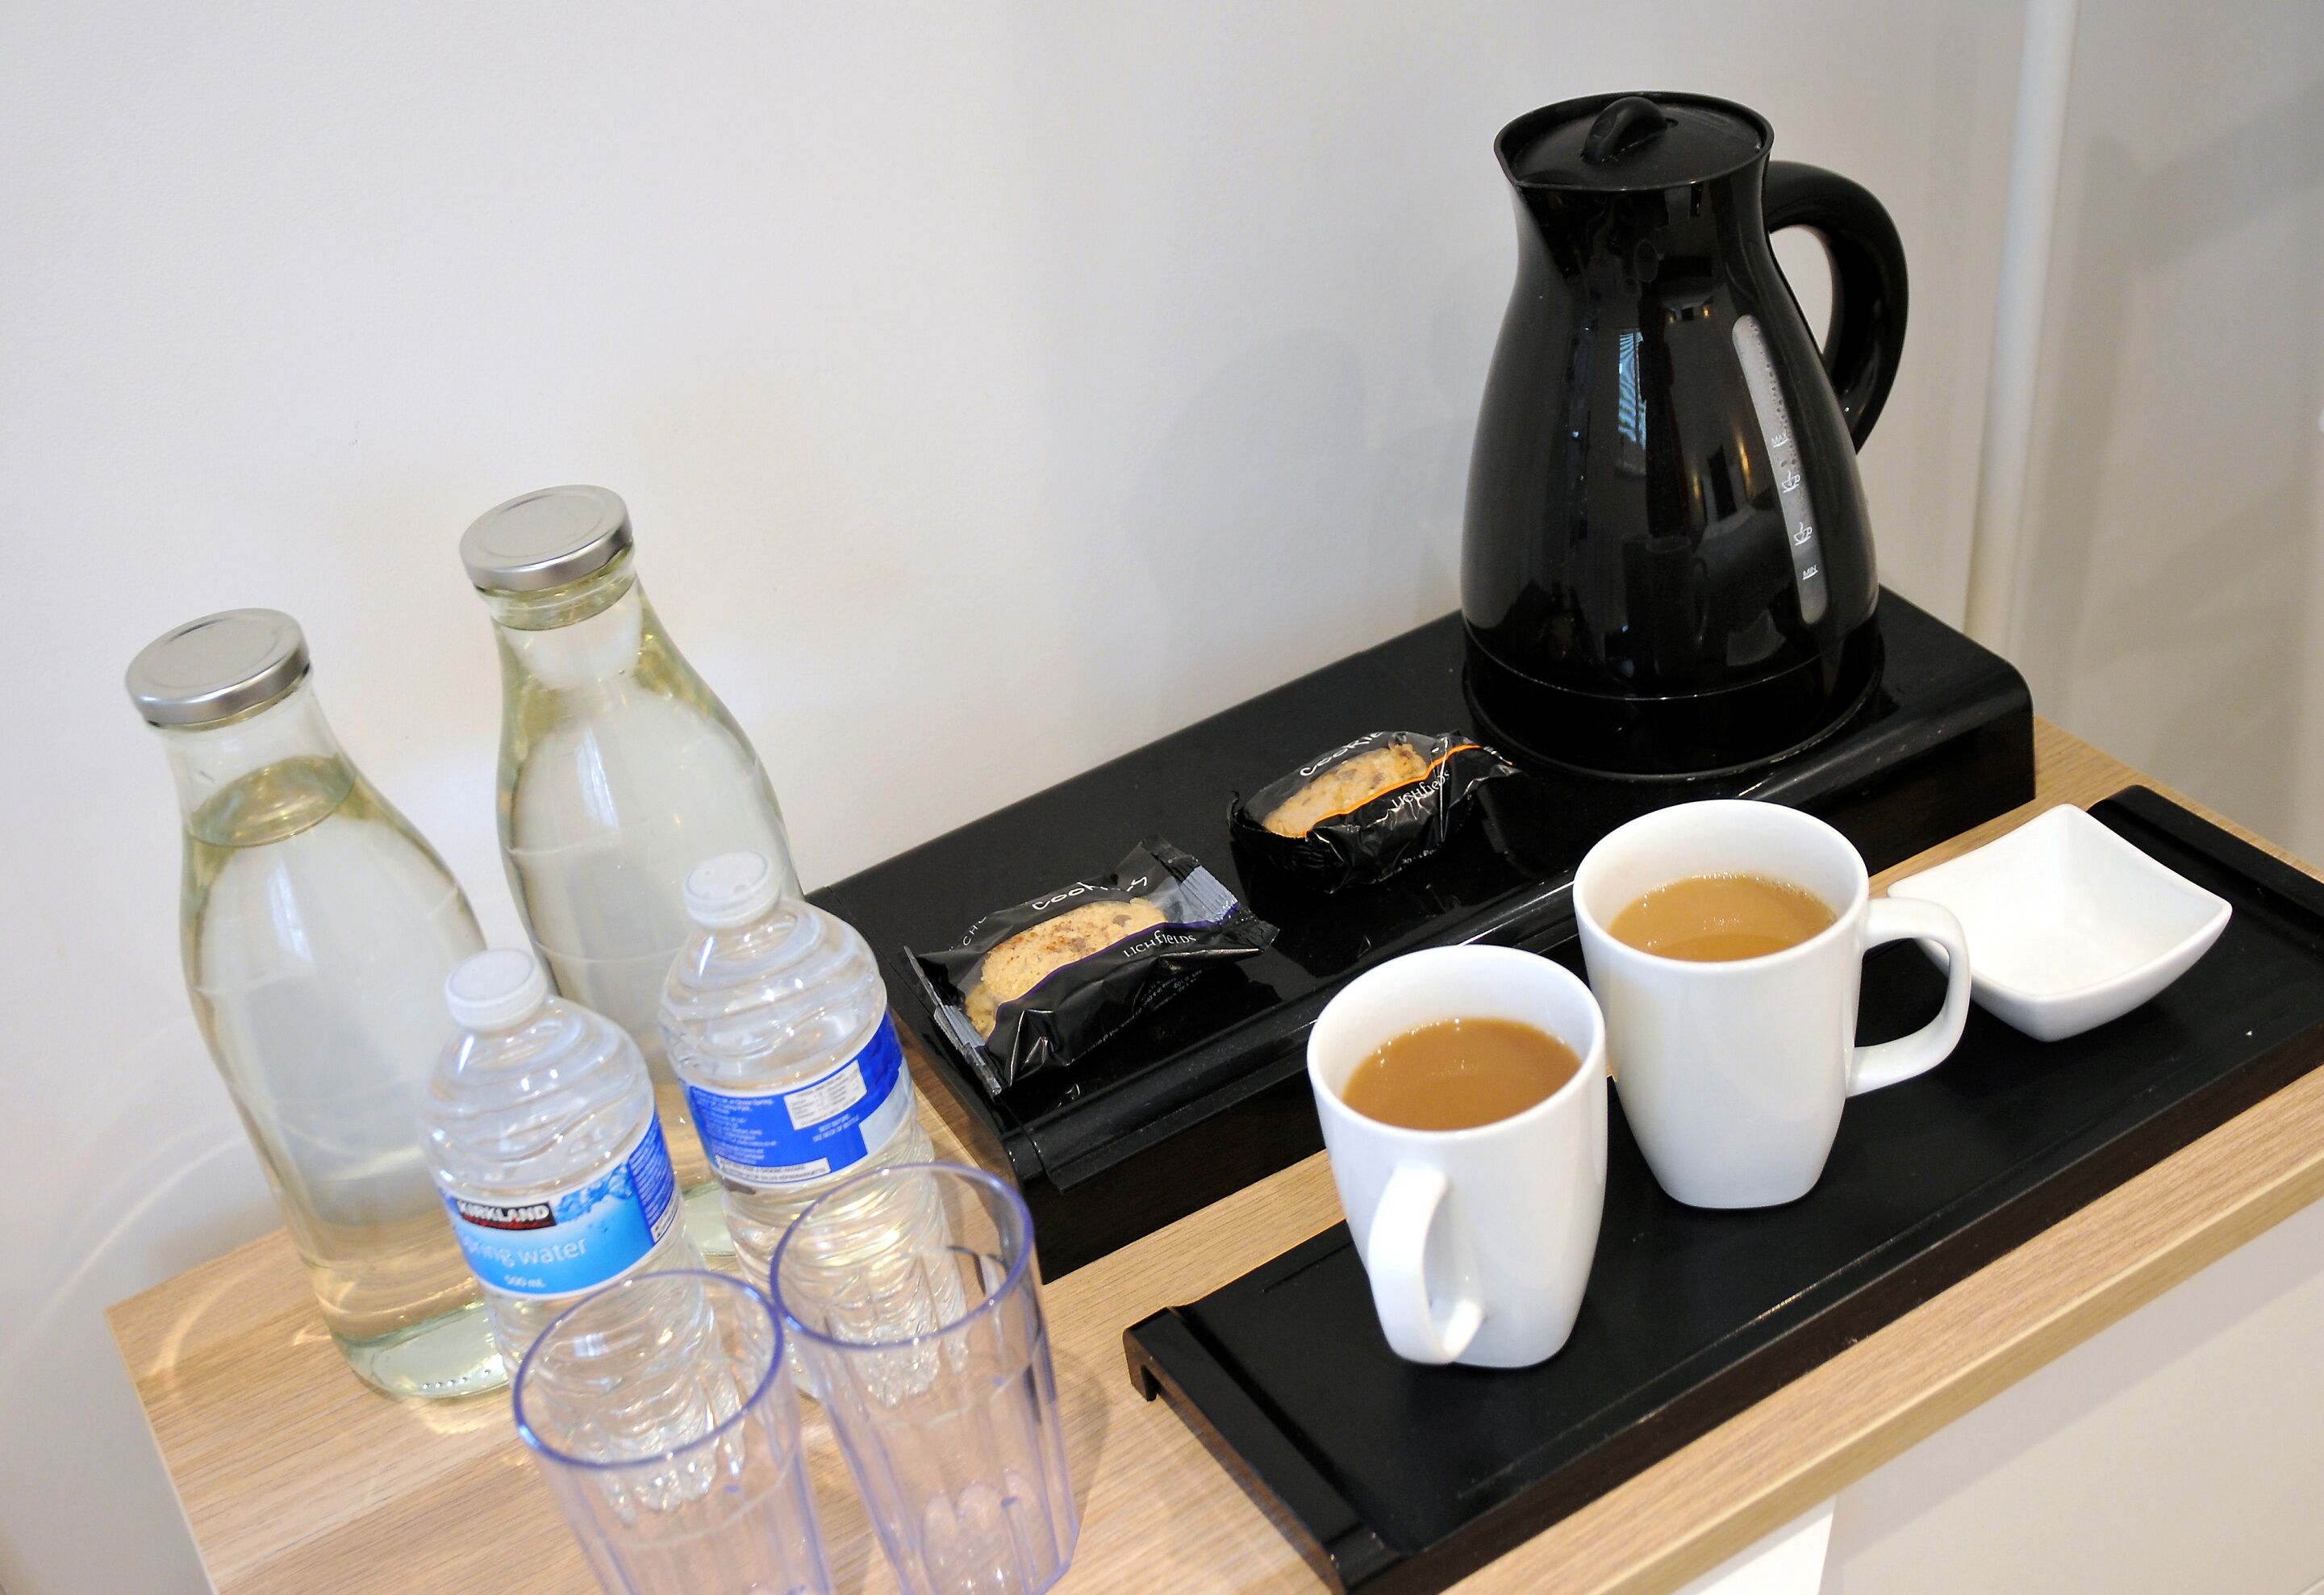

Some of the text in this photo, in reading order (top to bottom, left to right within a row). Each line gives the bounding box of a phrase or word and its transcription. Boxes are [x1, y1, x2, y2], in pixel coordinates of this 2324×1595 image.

[1771, 432, 1788, 445] MAX
[1802, 565, 1817, 578] MIN
[457, 1199, 550, 1222] KIRKLAND
[517, 1237, 586, 1265] water
[503, 1274, 527, 1288] 500
